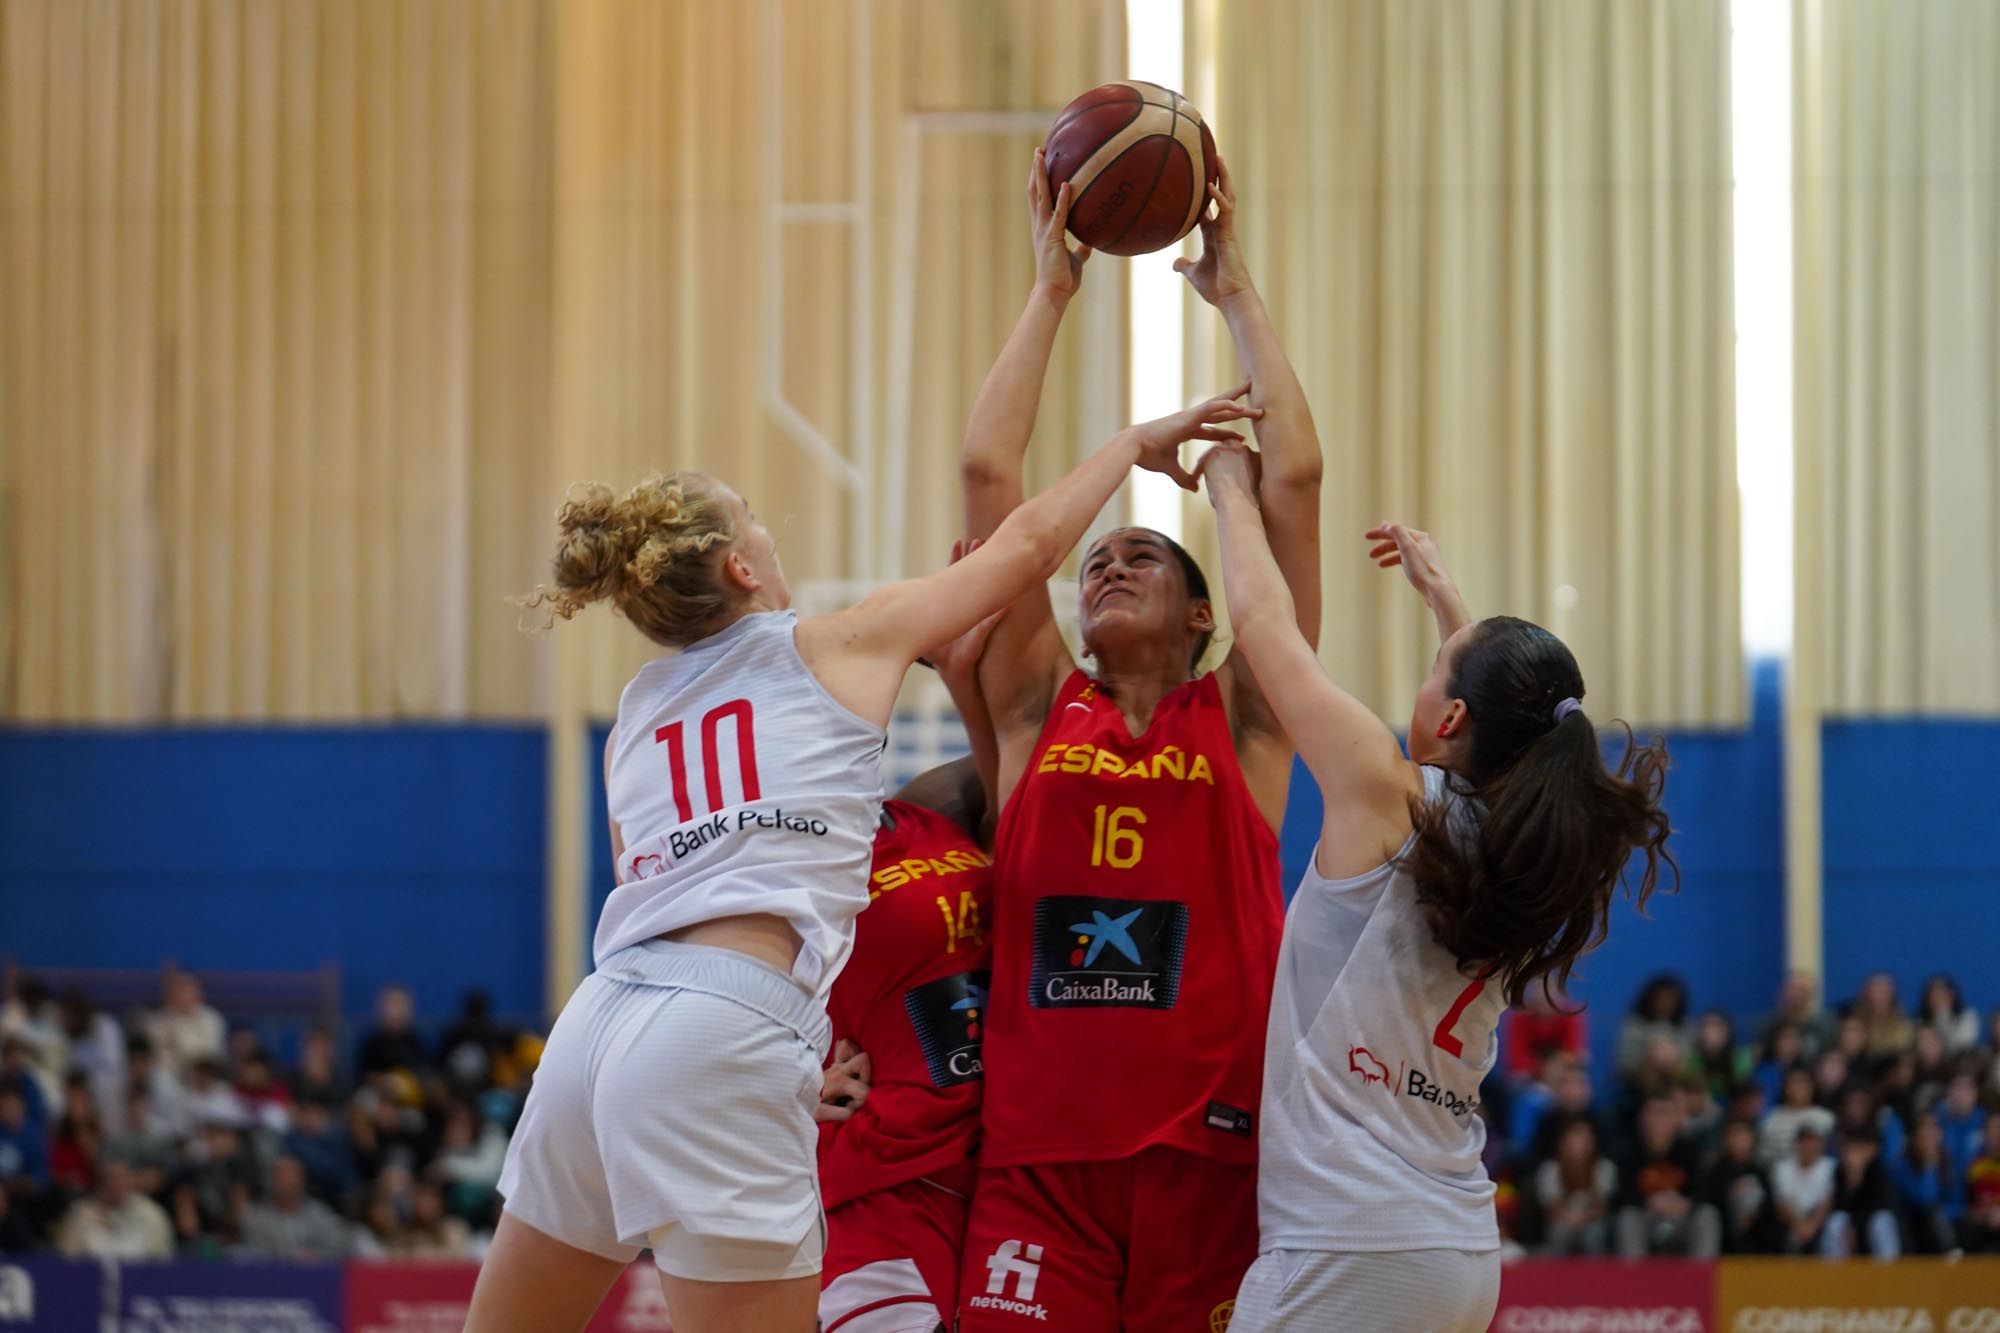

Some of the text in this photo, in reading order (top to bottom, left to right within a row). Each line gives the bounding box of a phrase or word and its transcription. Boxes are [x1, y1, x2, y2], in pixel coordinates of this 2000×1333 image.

[655, 698, 761, 824] 10
[1038, 743, 1215, 785] ESPAÑA
[669, 808, 828, 860] Bank Pekao
[1091, 804, 1147, 869] 16
[870, 849, 994, 902] SPAÑ
[936, 890, 984, 954] 14
[1045, 976, 1156, 1004] CaixaBank
[949, 1053, 984, 1076] Ca
[986, 1239, 1044, 1301] fi
[970, 1295, 1048, 1321] network
